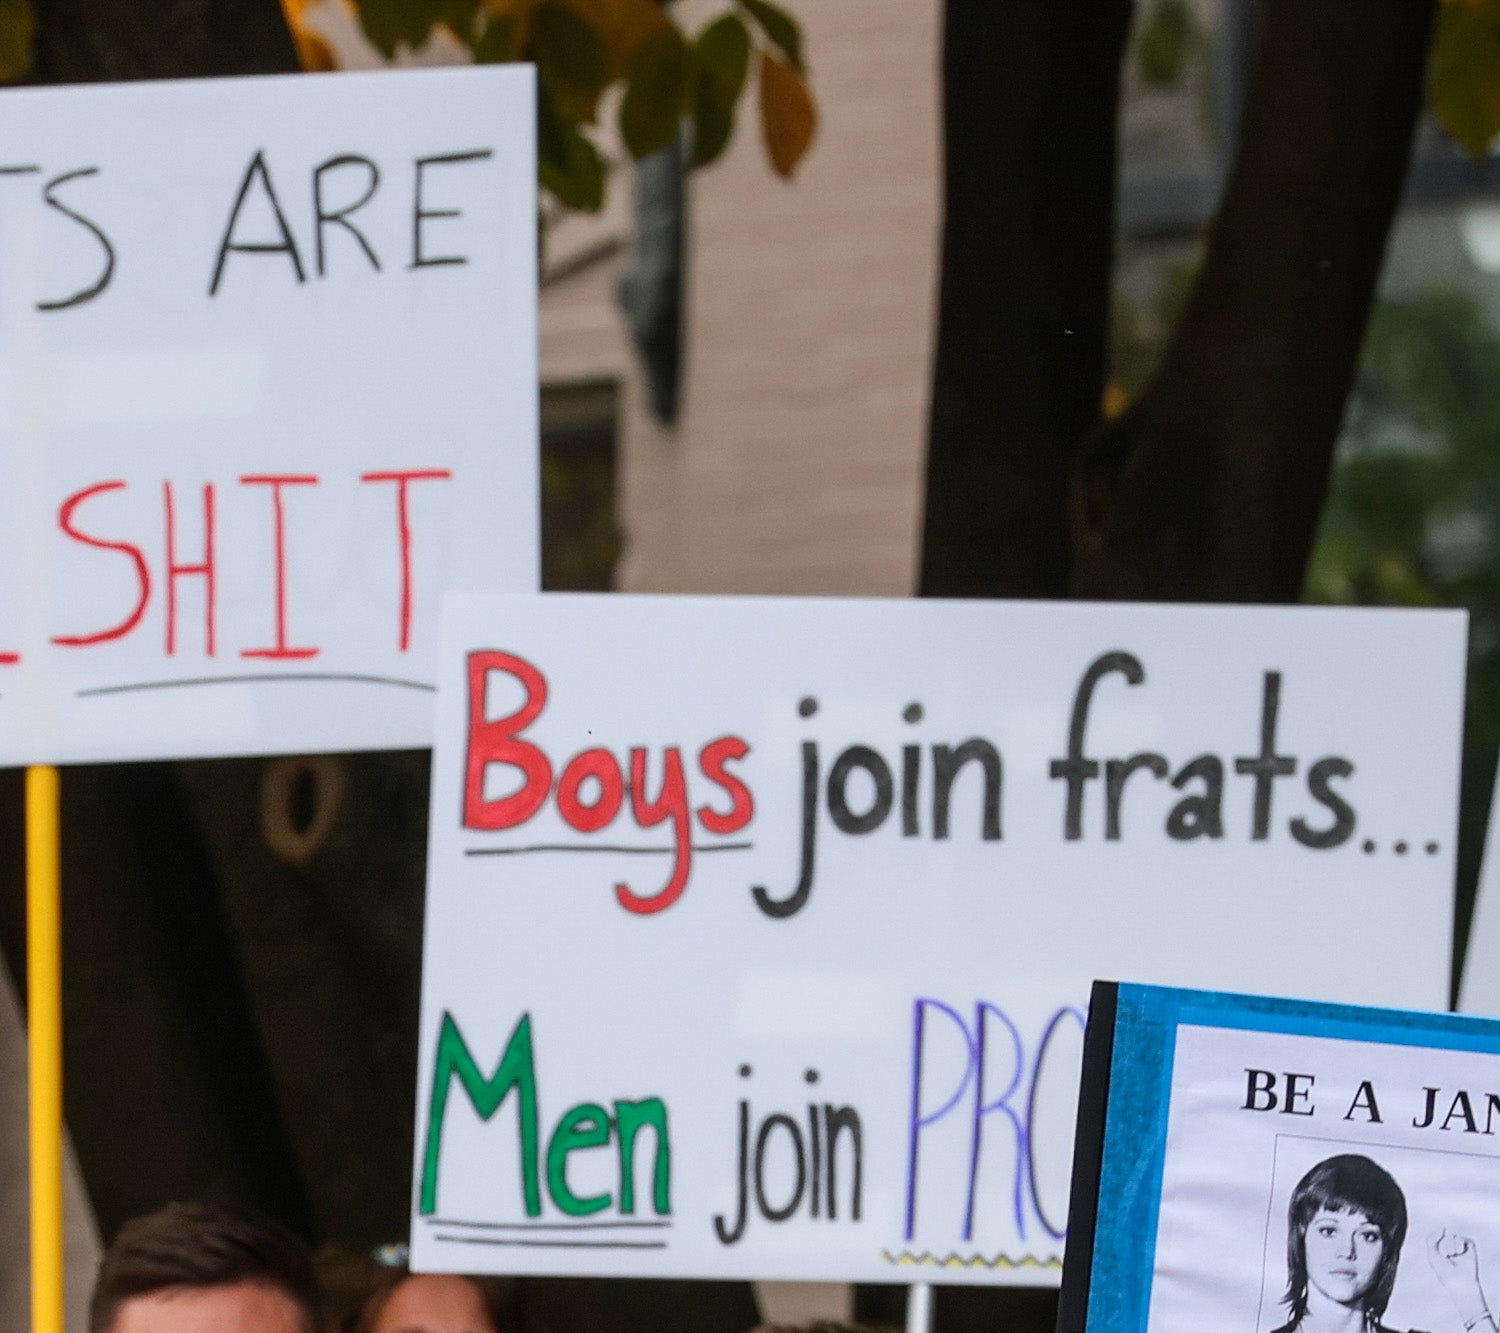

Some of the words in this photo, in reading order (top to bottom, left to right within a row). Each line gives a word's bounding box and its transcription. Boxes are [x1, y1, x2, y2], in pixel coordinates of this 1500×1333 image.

[208, 147, 493, 297] ARE
[462, 648, 756, 916] Boys
[750, 695, 1004, 920] join
[1048, 648, 1442, 855] frats...
[419, 1009, 672, 1219] Men
[714, 1063, 864, 1246] join
[1240, 1067, 1317, 1117] BE
[1343, 1080, 1384, 1124] A
